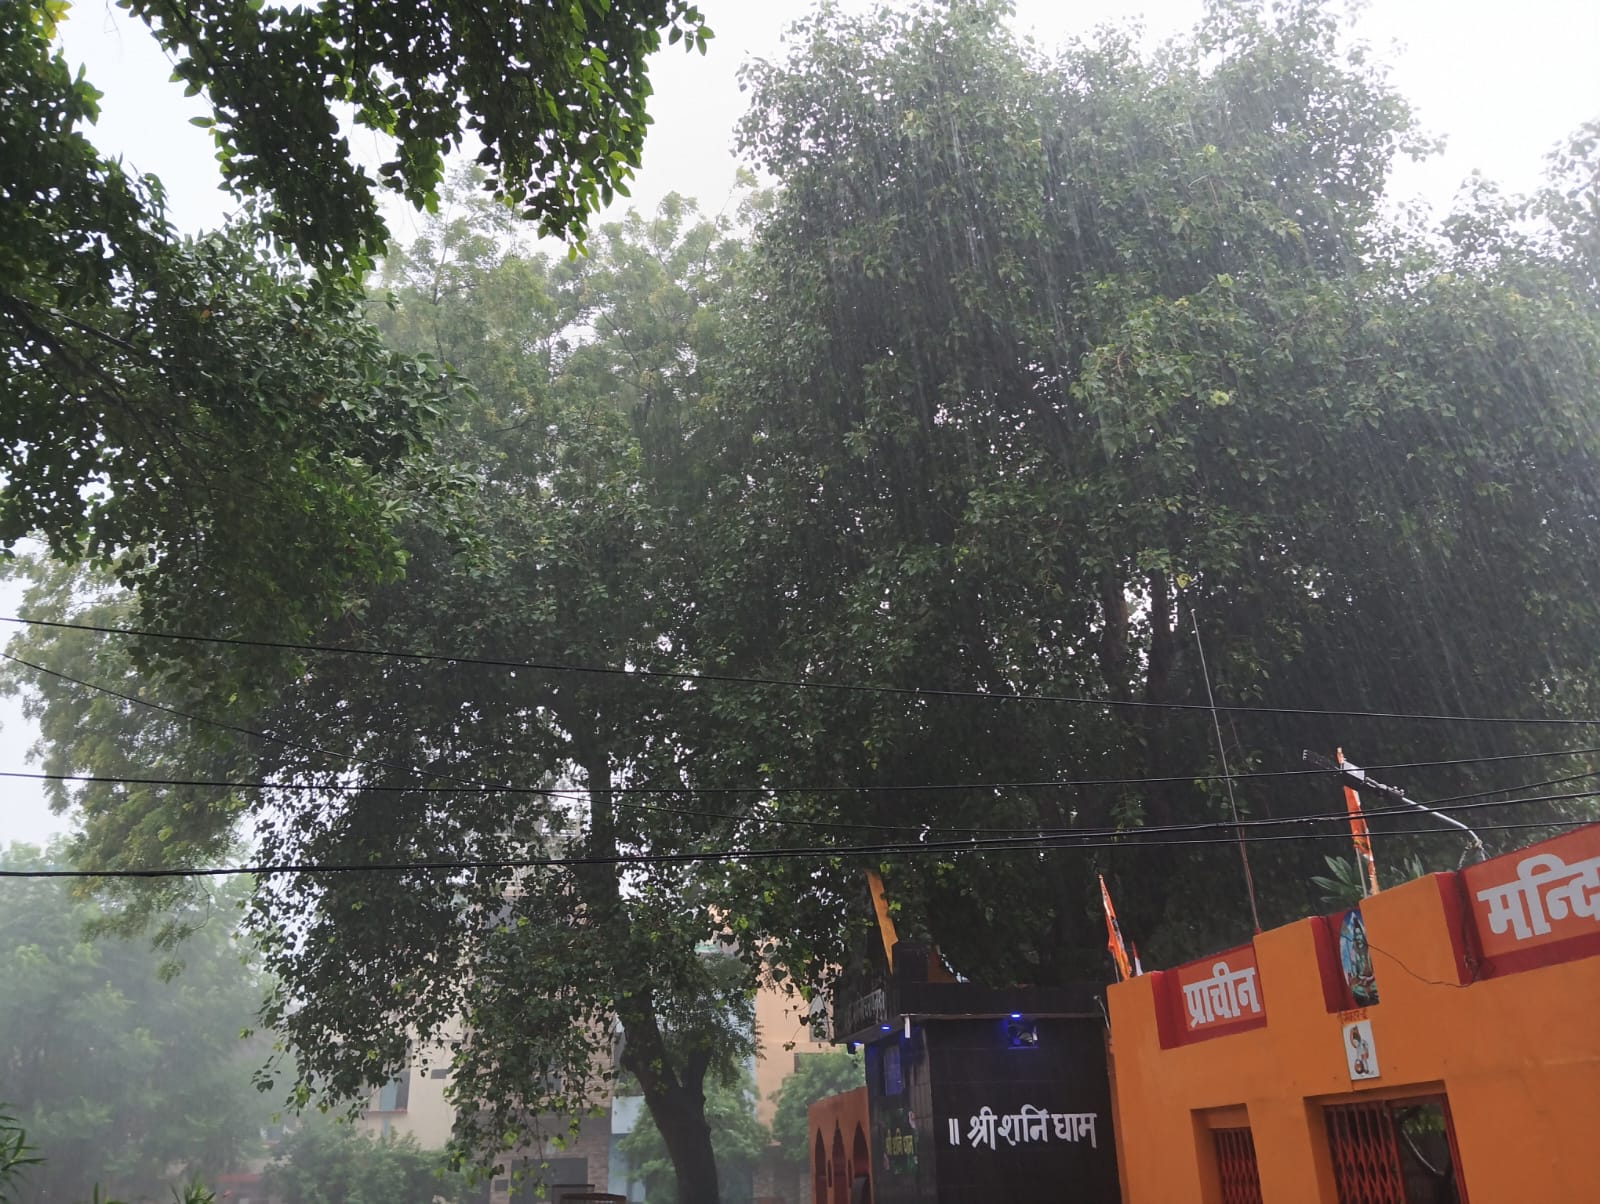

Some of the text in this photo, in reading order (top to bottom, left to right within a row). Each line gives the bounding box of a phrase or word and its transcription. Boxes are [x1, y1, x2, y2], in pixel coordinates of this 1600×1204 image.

[1182, 961, 1261, 1028] प्राचीन
[967, 1106, 996, 1149] श्री
[998, 1104, 1051, 1147] शनि
